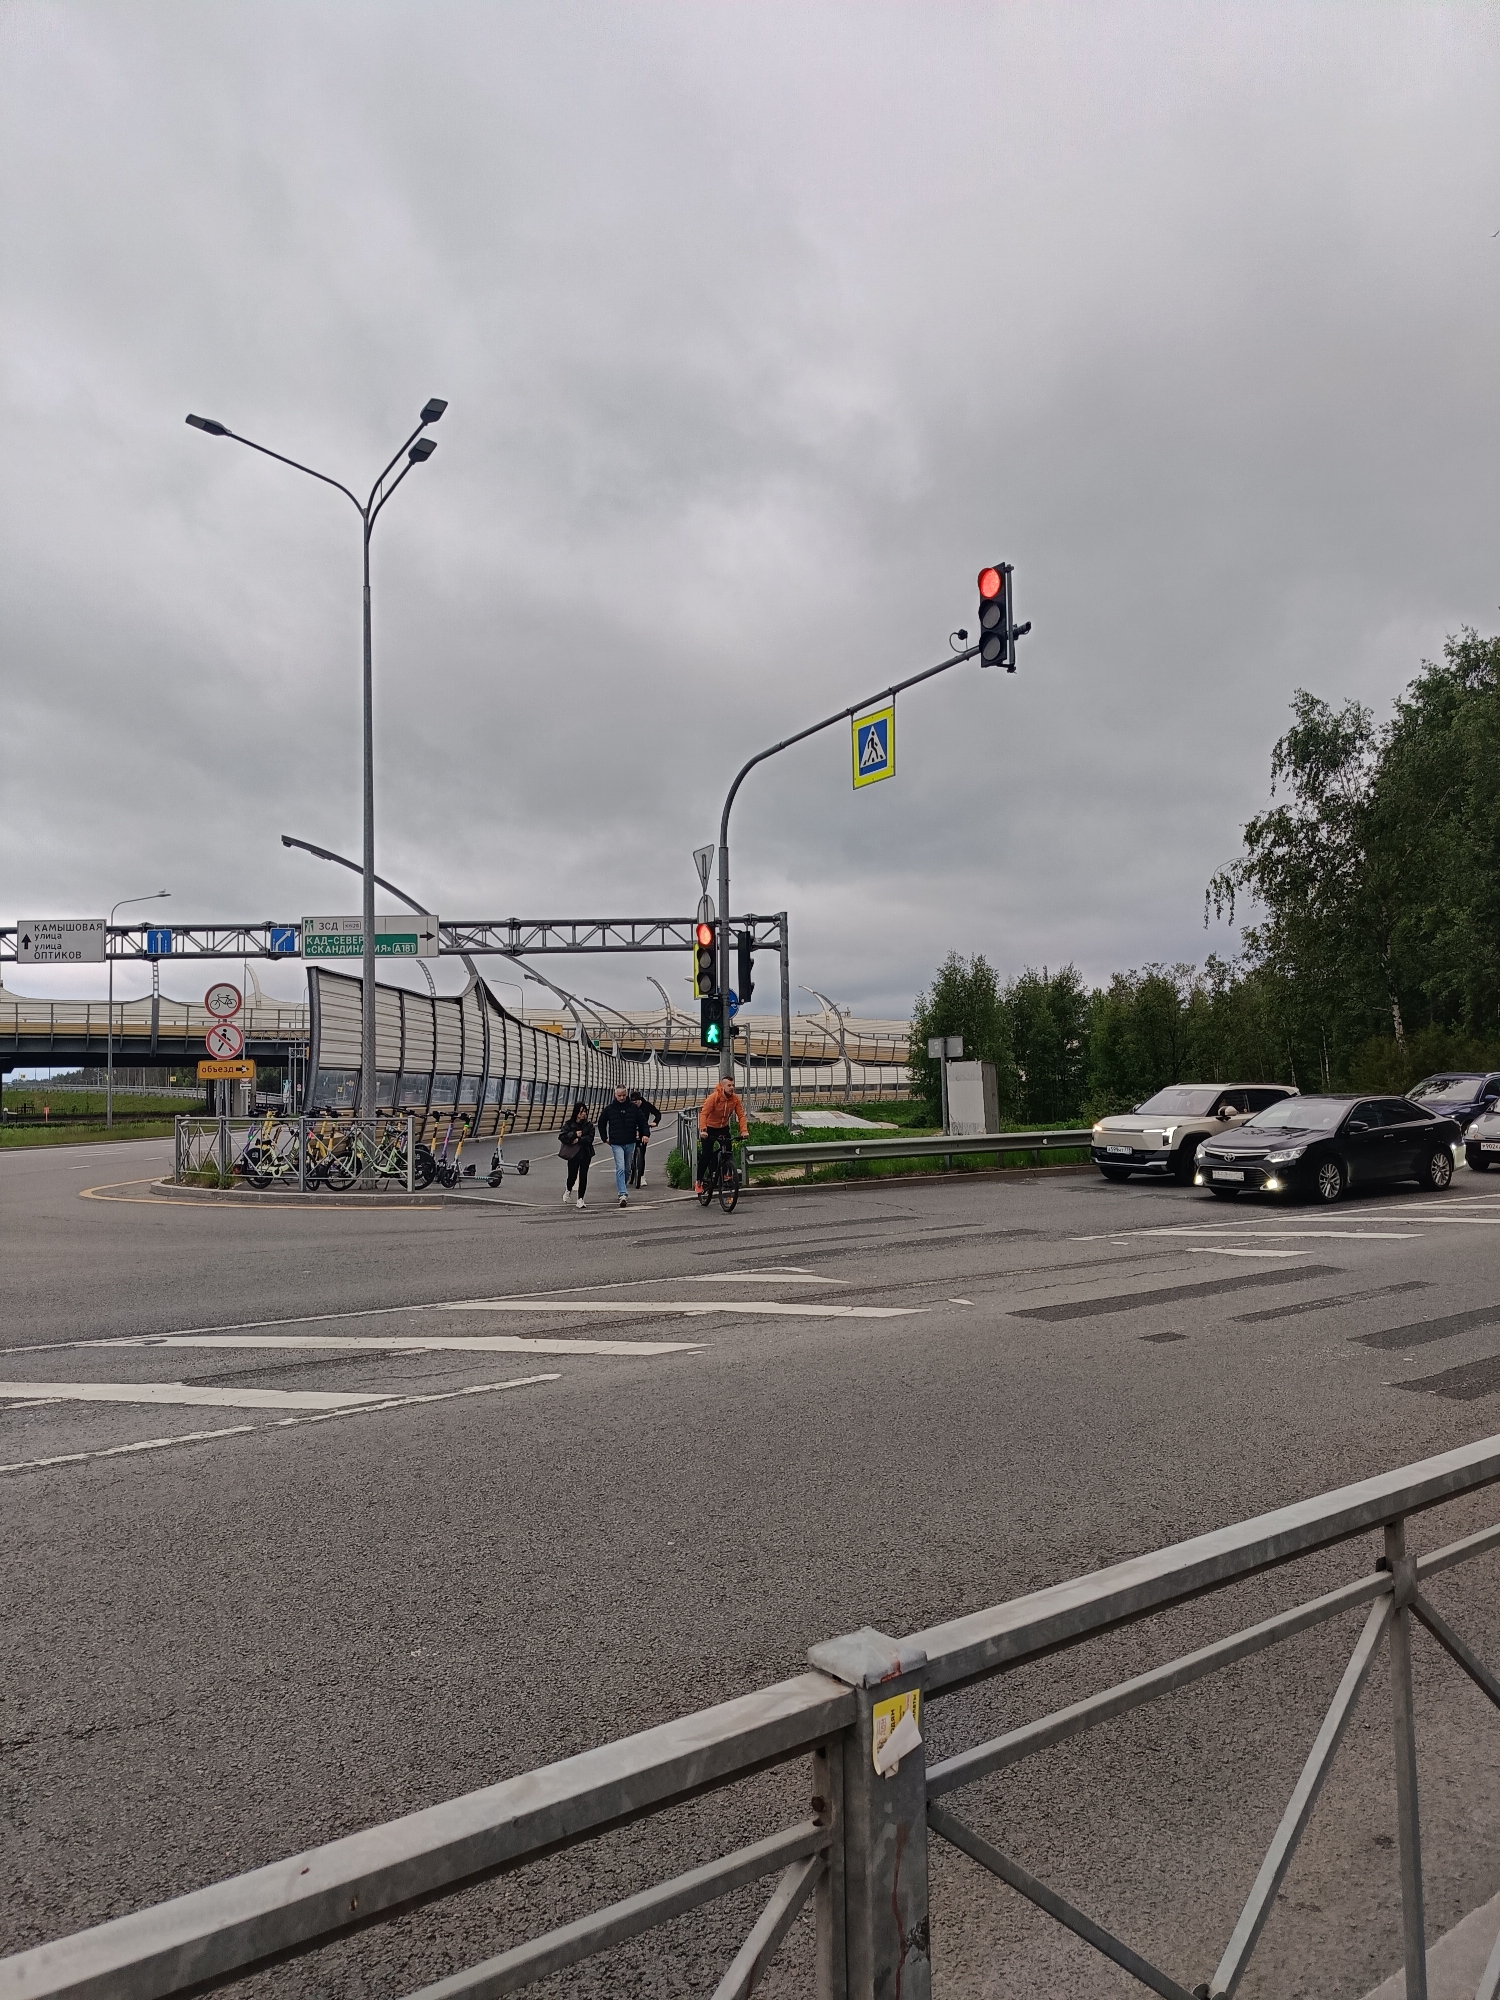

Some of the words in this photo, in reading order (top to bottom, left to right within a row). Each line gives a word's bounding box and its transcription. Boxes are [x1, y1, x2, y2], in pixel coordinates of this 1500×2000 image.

[34, 923, 103, 932] КАМЫШОВАЯ
[318, 922, 338, 931] ЗСД
[34, 933, 62, 941] улица
[306, 935, 364, 945] КАД-СЕВЕР
[34, 943, 62, 951] улица
[306, 944, 392, 955] «СКАНДИНАИЯ»
[394, 944, 415, 953] А181
[34, 951, 82, 960] ОПТИКОВ
[201, 1065, 234, 1073] объезд
